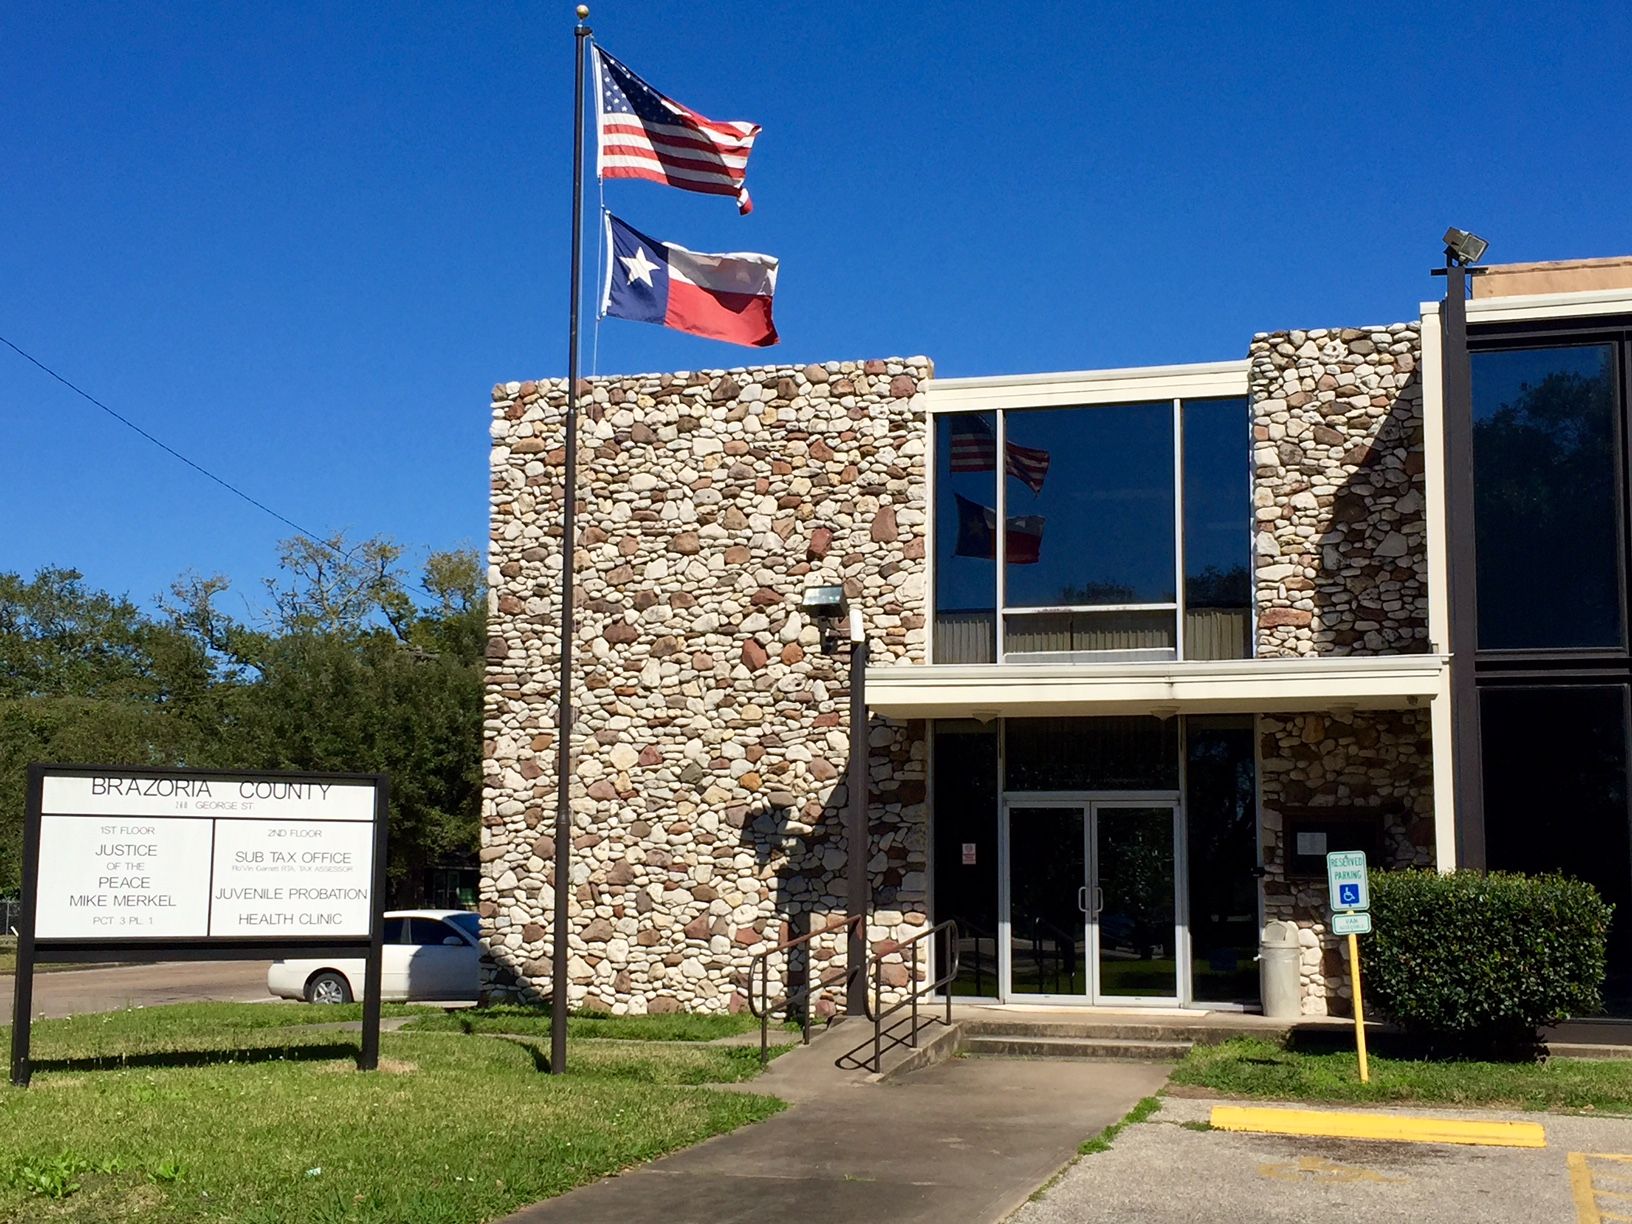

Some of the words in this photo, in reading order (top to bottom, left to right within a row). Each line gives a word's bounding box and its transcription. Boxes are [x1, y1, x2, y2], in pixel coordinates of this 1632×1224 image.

[91, 777, 212, 798] BRAZORIA
[239, 780, 332, 801] COUNTY
[195, 801, 238, 810] GEORGE
[100, 826, 117, 835] 1ST
[120, 826, 155, 835] FLOOR
[267, 829, 287, 838] 2ND
[290, 829, 322, 838] FLOOR
[95, 844, 158, 857] JUSTICE
[235, 851, 264, 863] SUB
[269, 851, 297, 863] TAX
[301, 852, 352, 864] OFFICE
[1331, 857, 1363, 867] RESERVED
[106, 862, 122, 871] OF
[125, 862, 145, 871] THE
[1334, 870, 1362, 880] PARKING
[98, 876, 151, 889] PEACE
[215, 888, 284, 900] JUVENILE
[288, 888, 368, 900] PROBATION
[69, 894, 108, 907] MIKE
[113, 894, 177, 907] MERKEL
[119, 916, 126, 926] 3
[148, 916, 153, 926] 1
[238, 913, 294, 925] HEALTH
[299, 913, 343, 925] CLINIC
